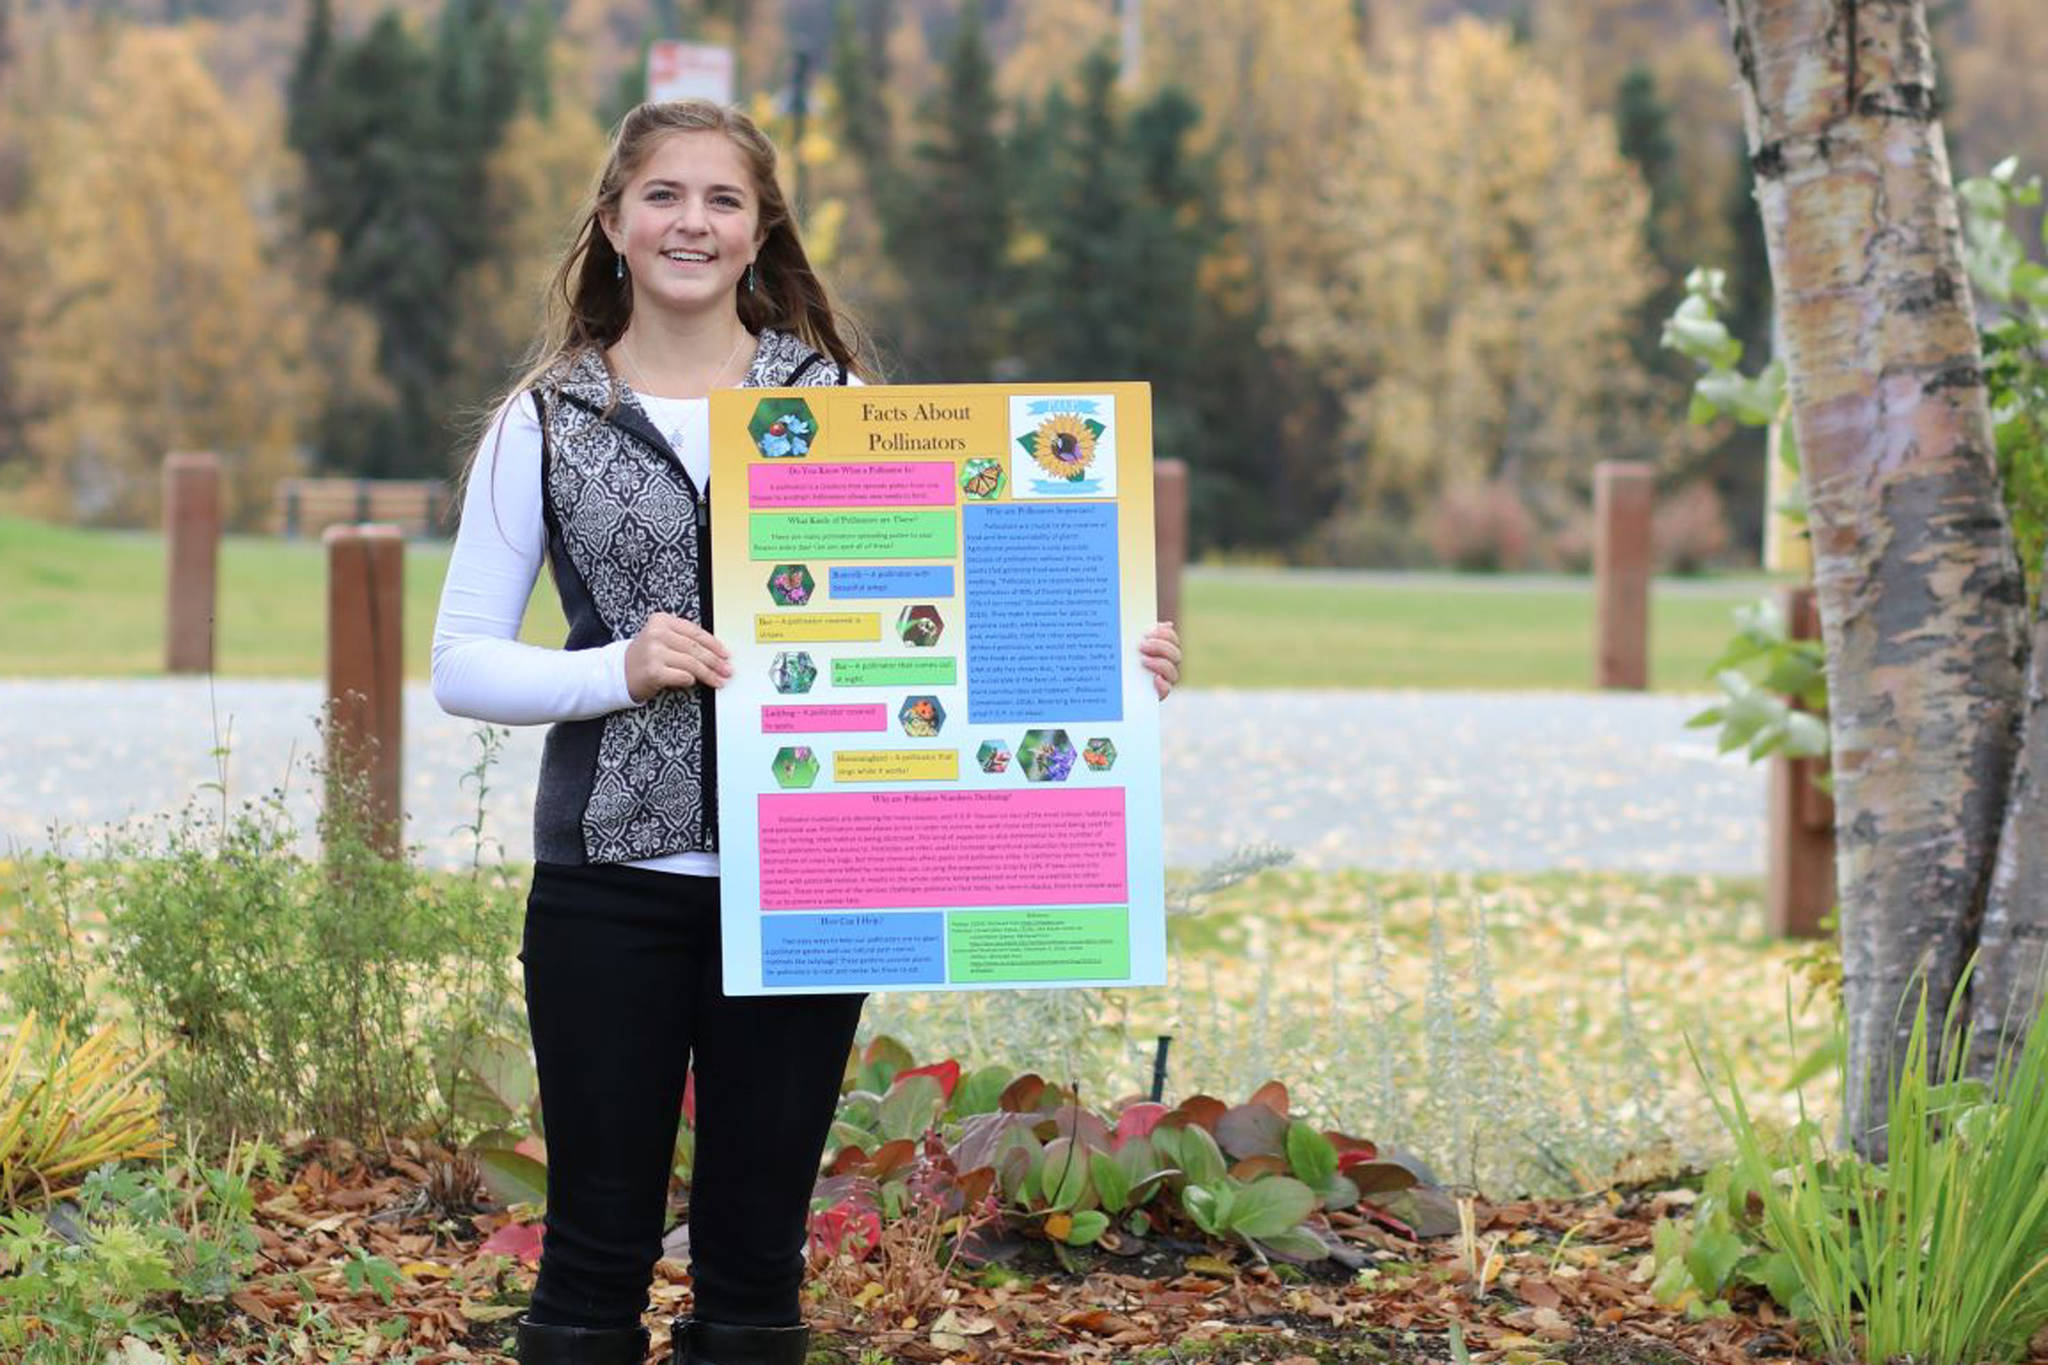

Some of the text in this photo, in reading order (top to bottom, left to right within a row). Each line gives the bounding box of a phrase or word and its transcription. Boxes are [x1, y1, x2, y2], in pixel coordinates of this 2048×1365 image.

[862, 402, 970, 423] Facts About
[868, 432, 966, 453] Pollinators
[801, 466, 817, 475] You
[819, 466, 839, 474] Know
[841, 466, 861, 474] What
[788, 517, 808, 525] What
[810, 516, 830, 525] Kinds
[841, 516, 878, 524] Pollinators
[872, 795, 890, 804] Why
[821, 917, 840, 926] How
[840, 917, 854, 926] Can
[860, 917, 885, 927] Help?
